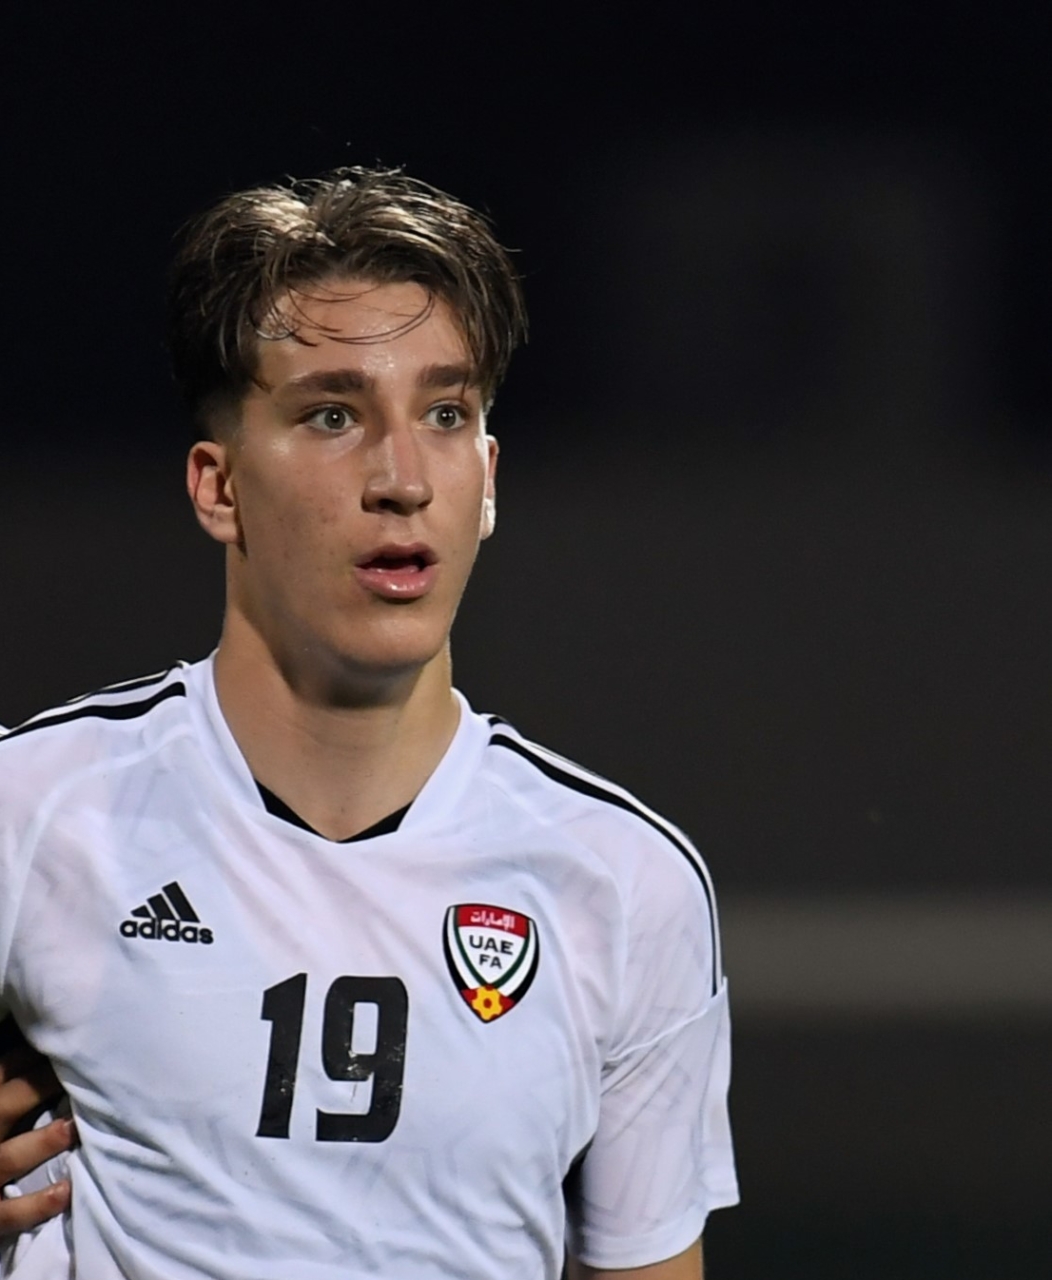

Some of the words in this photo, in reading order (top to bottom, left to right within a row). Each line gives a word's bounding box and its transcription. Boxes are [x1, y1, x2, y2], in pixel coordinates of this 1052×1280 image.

[120, 917, 214, 945] adidas
[469, 934, 514, 955] UAE
[479, 954, 503, 969] FA
[256, 972, 409, 1142] 19
